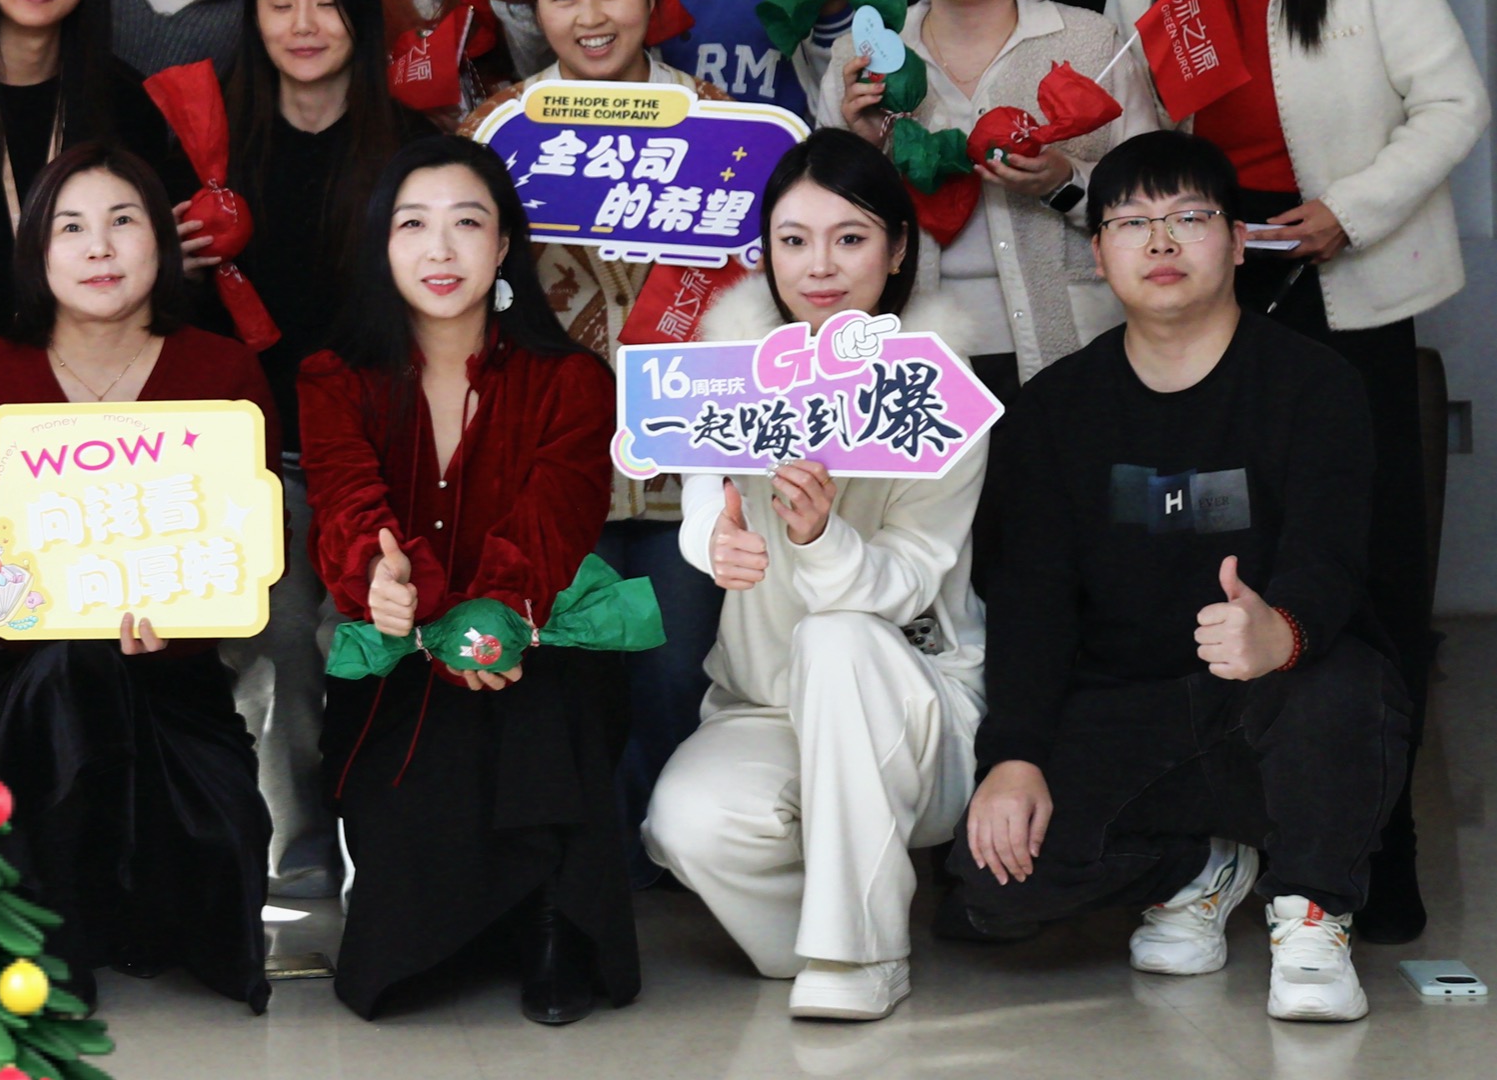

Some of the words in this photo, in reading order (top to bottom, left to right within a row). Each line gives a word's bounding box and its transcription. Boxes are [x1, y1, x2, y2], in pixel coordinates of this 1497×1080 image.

[1161, 3, 1180, 40] GREEN
[1173, 38, 1194, 81] SOURCE
[543, 96, 570, 106] THE
[573, 97, 609, 108] HOPE
[612, 98, 630, 108] OF
[633, 99, 660, 109] THE
[543, 107, 591, 118] ENTIRE
[593, 109, 660, 121] COMPANY
[530, 129, 689, 184] 全公司
[595, 181, 755, 237] 的希望
[642, 356, 746, 400] 16周年庆
[30, 416, 78, 433] money
[103, 414, 150, 432] money
[646, 362, 965, 460] 一起嗨到爆
[20, 431, 165, 479] WOW
[1165, 489, 1183, 515] H
